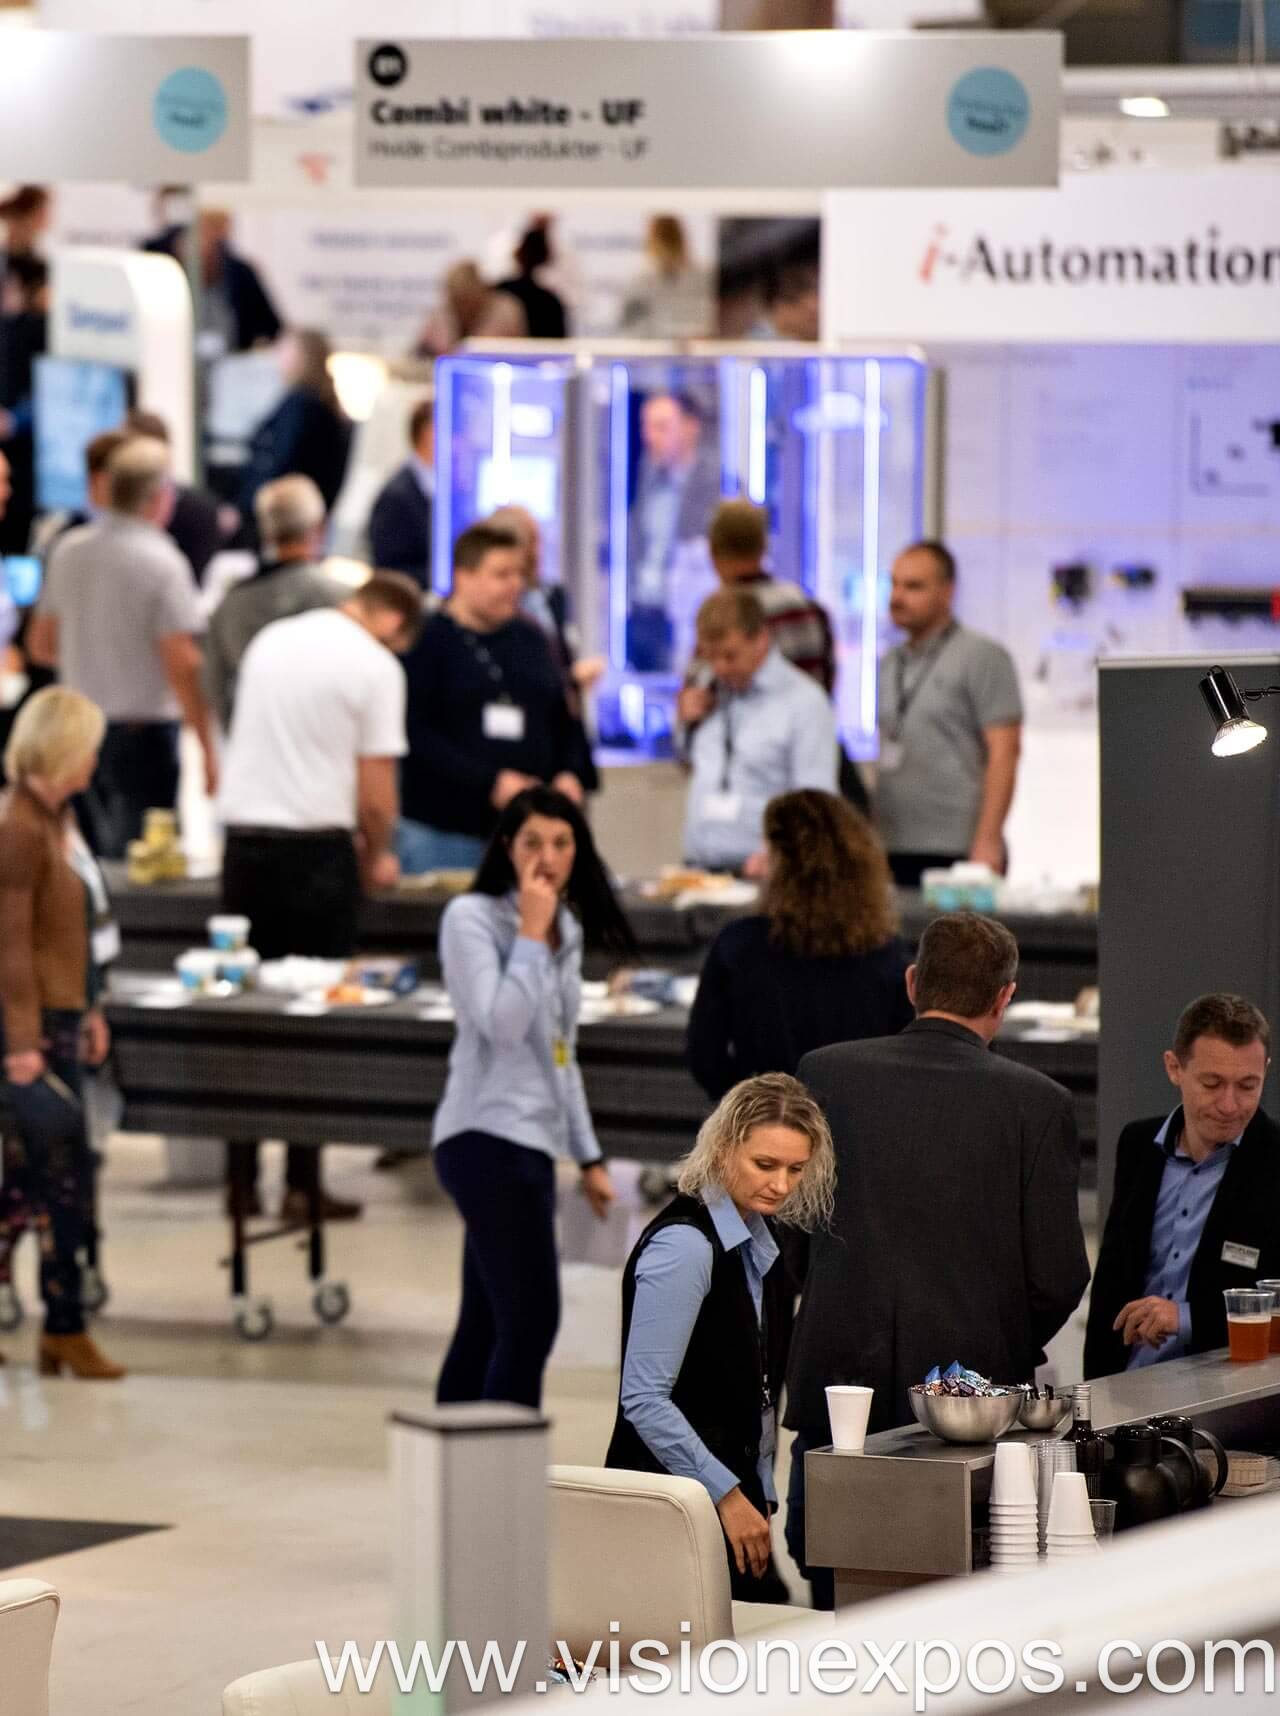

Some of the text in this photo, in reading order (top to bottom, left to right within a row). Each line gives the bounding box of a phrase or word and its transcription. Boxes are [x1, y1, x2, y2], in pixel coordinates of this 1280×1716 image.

[370, 97, 469, 125] Combi
[480, 96, 570, 125] white
[601, 98, 644, 125] UF
